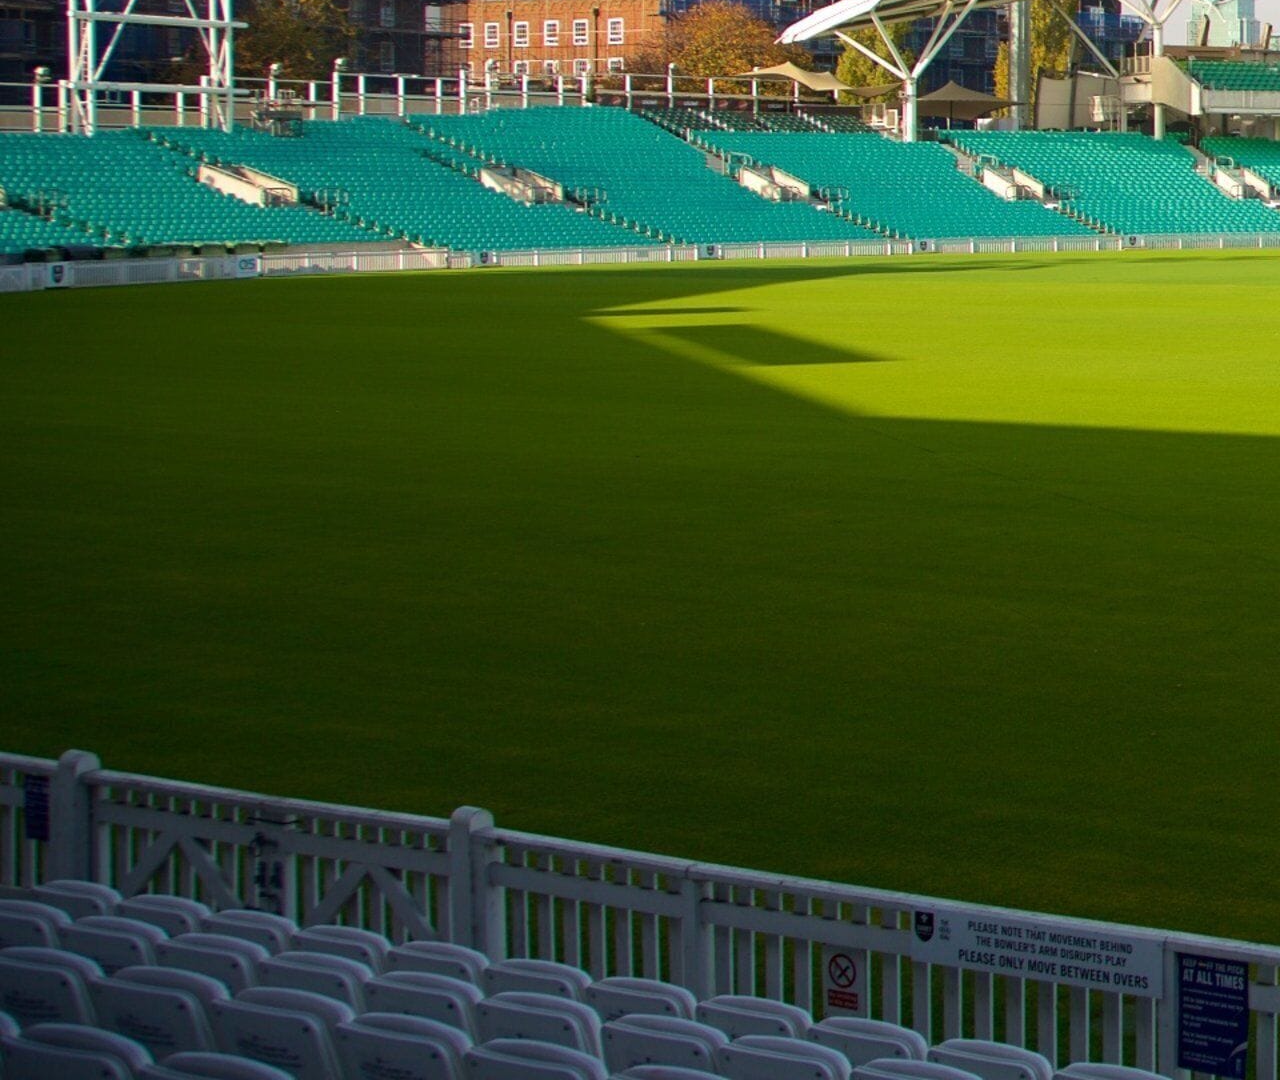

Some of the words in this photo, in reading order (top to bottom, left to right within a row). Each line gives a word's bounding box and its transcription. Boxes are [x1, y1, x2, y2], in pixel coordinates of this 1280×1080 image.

[968, 920, 999, 935] PLEASE
[1001, 926, 1022, 939] NOTE
[1025, 929, 1047, 942] THAT
[1048, 932, 1097, 950] MOVEMENT
[1100, 940, 1133, 955] BEHIND
[976, 935, 992, 947] THE
[994, 938, 1037, 954] BOWLER'S
[1038, 945, 1058, 958] ARM
[1060, 948, 1103, 964] DISRUPTS
[1104, 955, 1127, 968] PLAY
[958, 949, 995, 966] PLEASE
[998, 955, 1025, 970] ONLY
[1027, 959, 1058, 976] MOVE
[1060, 965, 1111, 984] BETWEEN
[1113, 973, 1149, 990] OVERS
[1183, 968, 1195, 983] AT
[1196, 970, 1213, 986] ALL
[1215, 972, 1244, 990] TIMES
